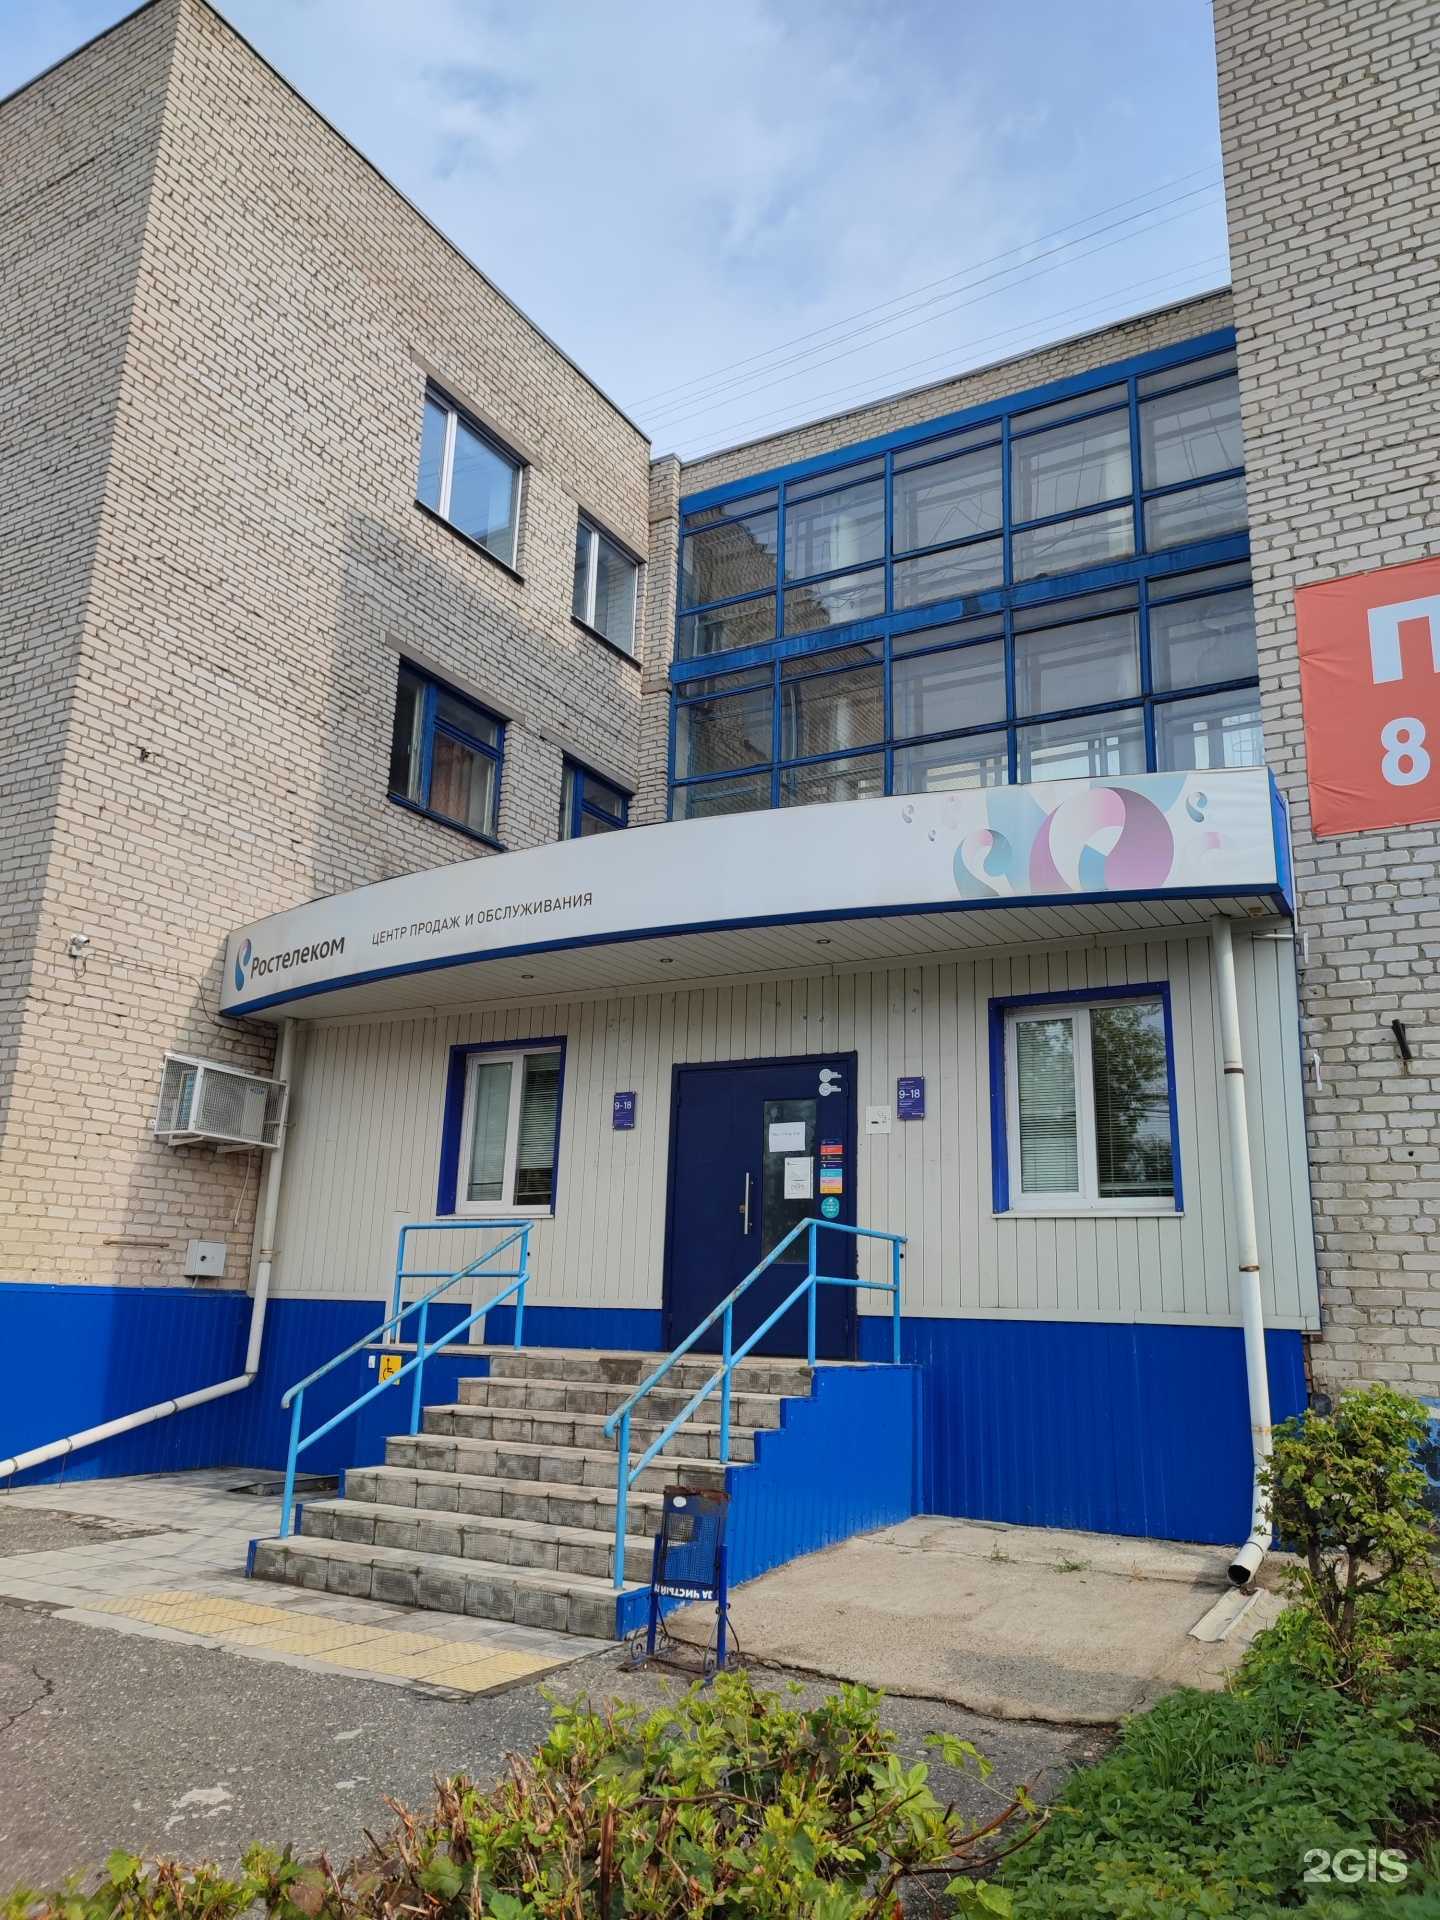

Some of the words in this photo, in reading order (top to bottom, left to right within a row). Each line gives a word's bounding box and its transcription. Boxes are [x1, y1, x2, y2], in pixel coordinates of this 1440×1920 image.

[1380, 717, 1431, 786] 8
[371, 926, 408, 946] ЦЕНТР
[409, 915, 461, 937] ПРОДАЖ
[464, 913, 474, 927] И
[476, 892, 593, 924] ОБСЛУЖИВАНИЯ
[250, 936, 345, 979] Ростелеком
[898, 1088, 921, 1099] 9-18
